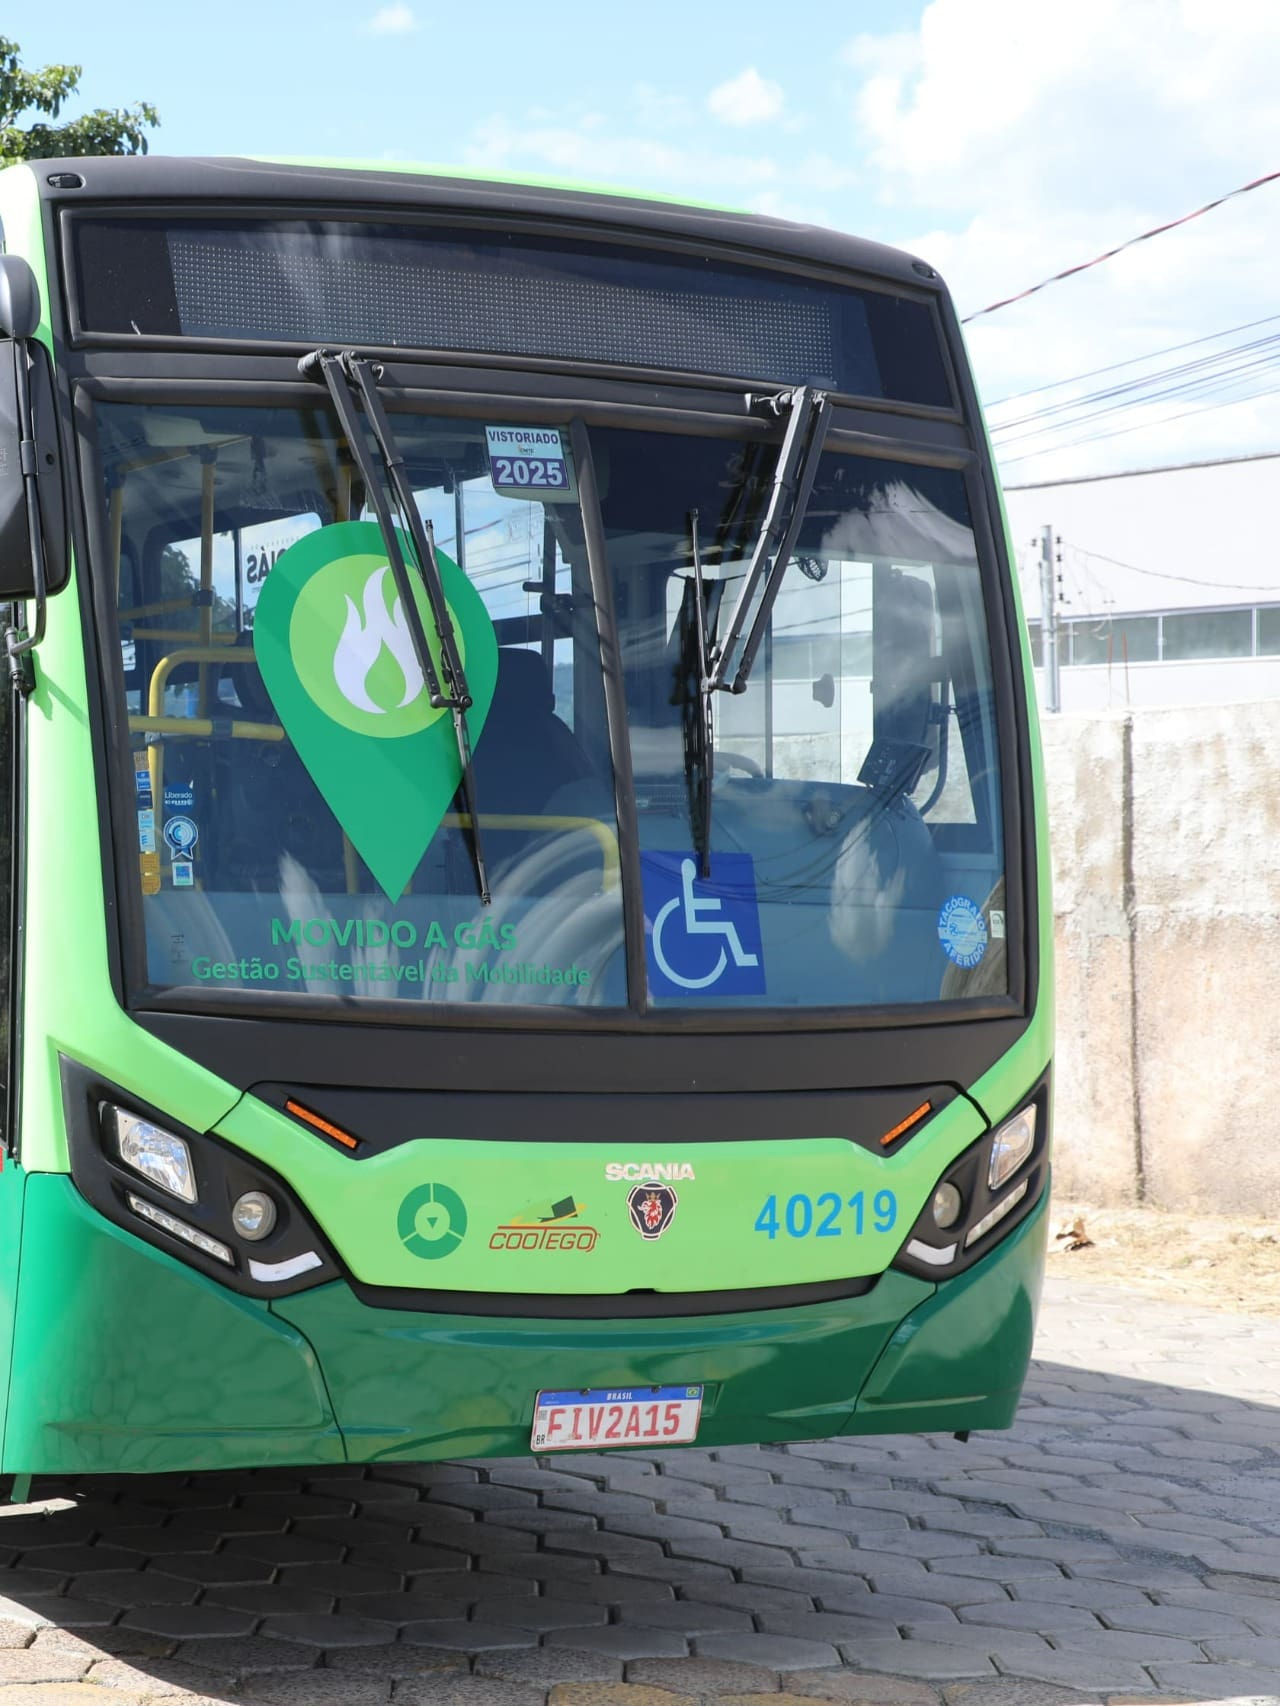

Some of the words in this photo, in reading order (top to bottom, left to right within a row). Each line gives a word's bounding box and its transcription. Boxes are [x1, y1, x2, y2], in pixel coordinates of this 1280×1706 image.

[488, 430, 559, 445] VISTORIADO
[495, 459, 563, 486] 2025
[164, 791, 193, 799] Liberado
[270, 917, 416, 949] MOVIDO
[423, 921, 448, 949] A
[453, 916, 517, 951] GÁS
[943, 942, 985, 967] AFERIDO
[191, 956, 279, 981] Gestão
[287, 957, 425, 982] Sustentável
[431, 961, 460, 983] da
[465, 963, 592, 986] Mobilidade
[604, 1162, 696, 1181] SCANIA
[754, 1189, 897, 1239] 40219
[489, 1225, 600, 1253] COOTEGO
[606, 1391, 633, 1401] BRASIL
[546, 1403, 682, 1442] FIV2A15
[535, 1434, 546, 1445] BR
